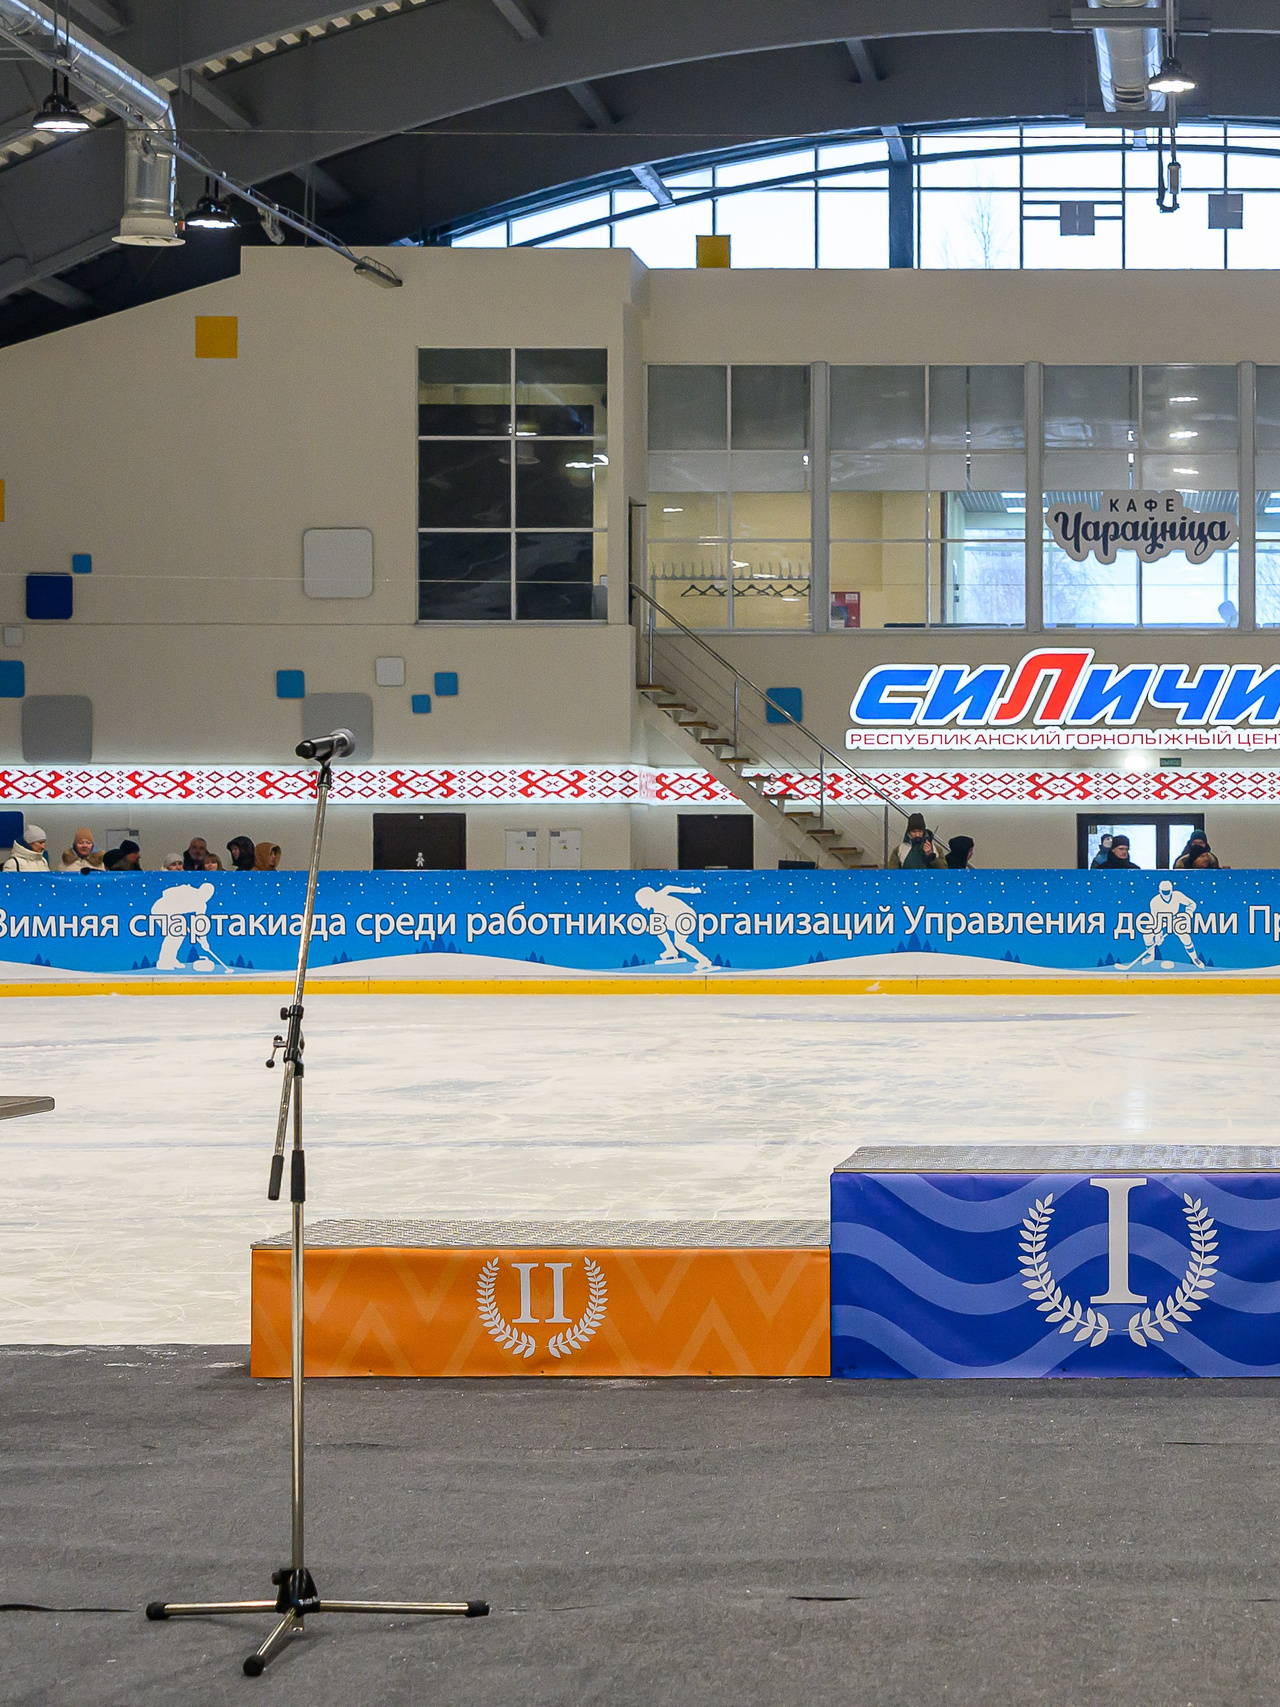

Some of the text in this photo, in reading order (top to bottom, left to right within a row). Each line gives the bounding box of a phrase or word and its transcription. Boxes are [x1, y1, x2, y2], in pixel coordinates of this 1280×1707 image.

[1109, 498, 1175, 513] КАФЕ
[1053, 511, 1231, 557] Чараўніца
[850, 730, 1060, 745] РЕСПУБЛИКАНСКИЙ
[1066, 730, 1231, 745] ГОРНОЛЫЖНЫЙ
[129, 911, 347, 943] спартакиада
[355, 911, 457, 943] среди
[466, 903, 668, 943] работников
[675, 904, 895, 942] организаций
[902, 904, 1105, 942] Управления
[1113, 911, 1238, 941] делами
[511, 1262, 573, 1324] II
